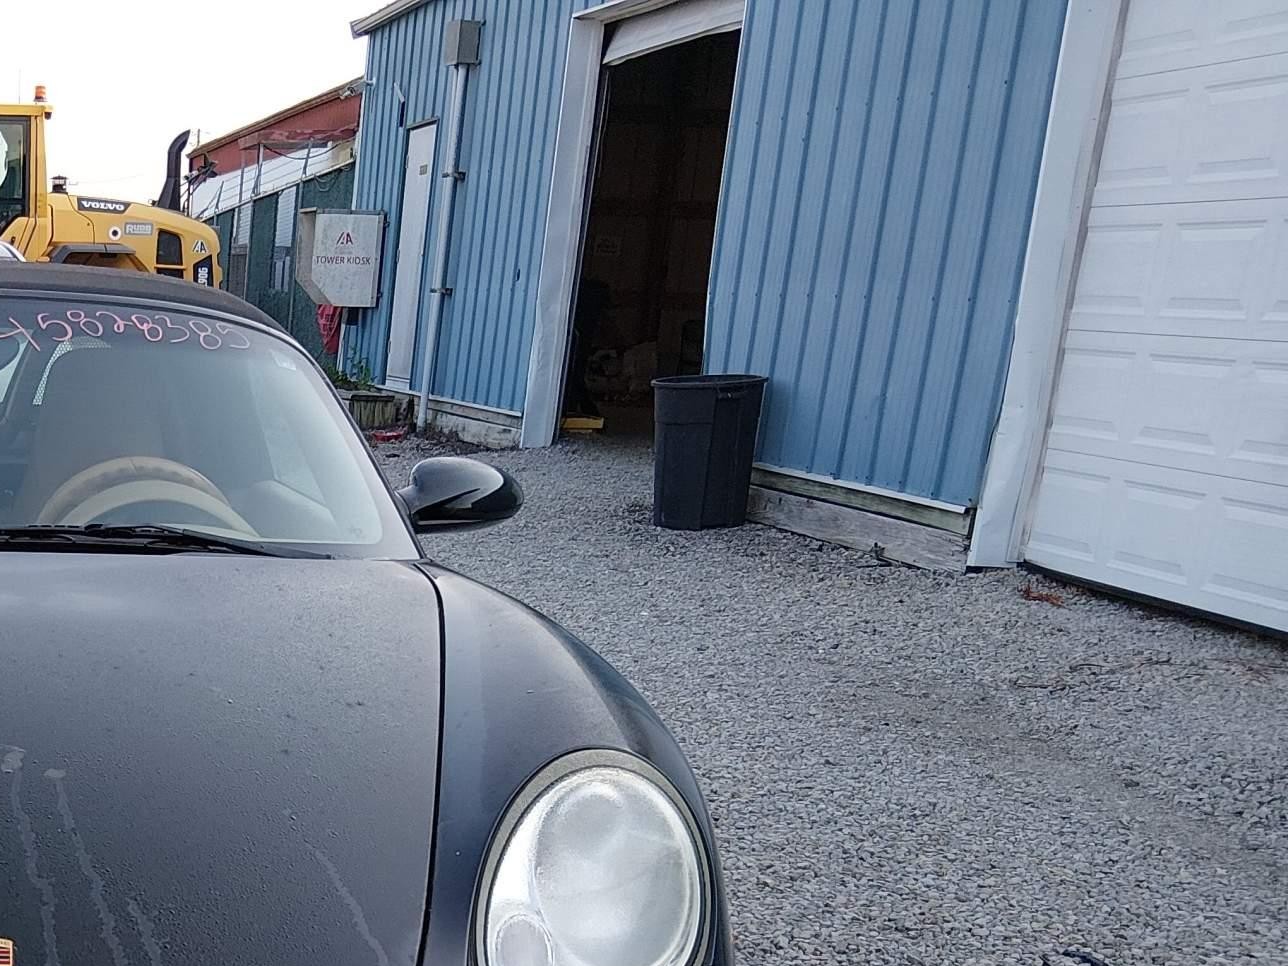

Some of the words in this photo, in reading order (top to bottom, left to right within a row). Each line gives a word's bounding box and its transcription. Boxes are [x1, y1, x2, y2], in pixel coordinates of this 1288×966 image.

[81, 200, 125, 211] VOLVO
[316, 255, 345, 265] TOWER
[346, 256, 371, 265] KIOSK
